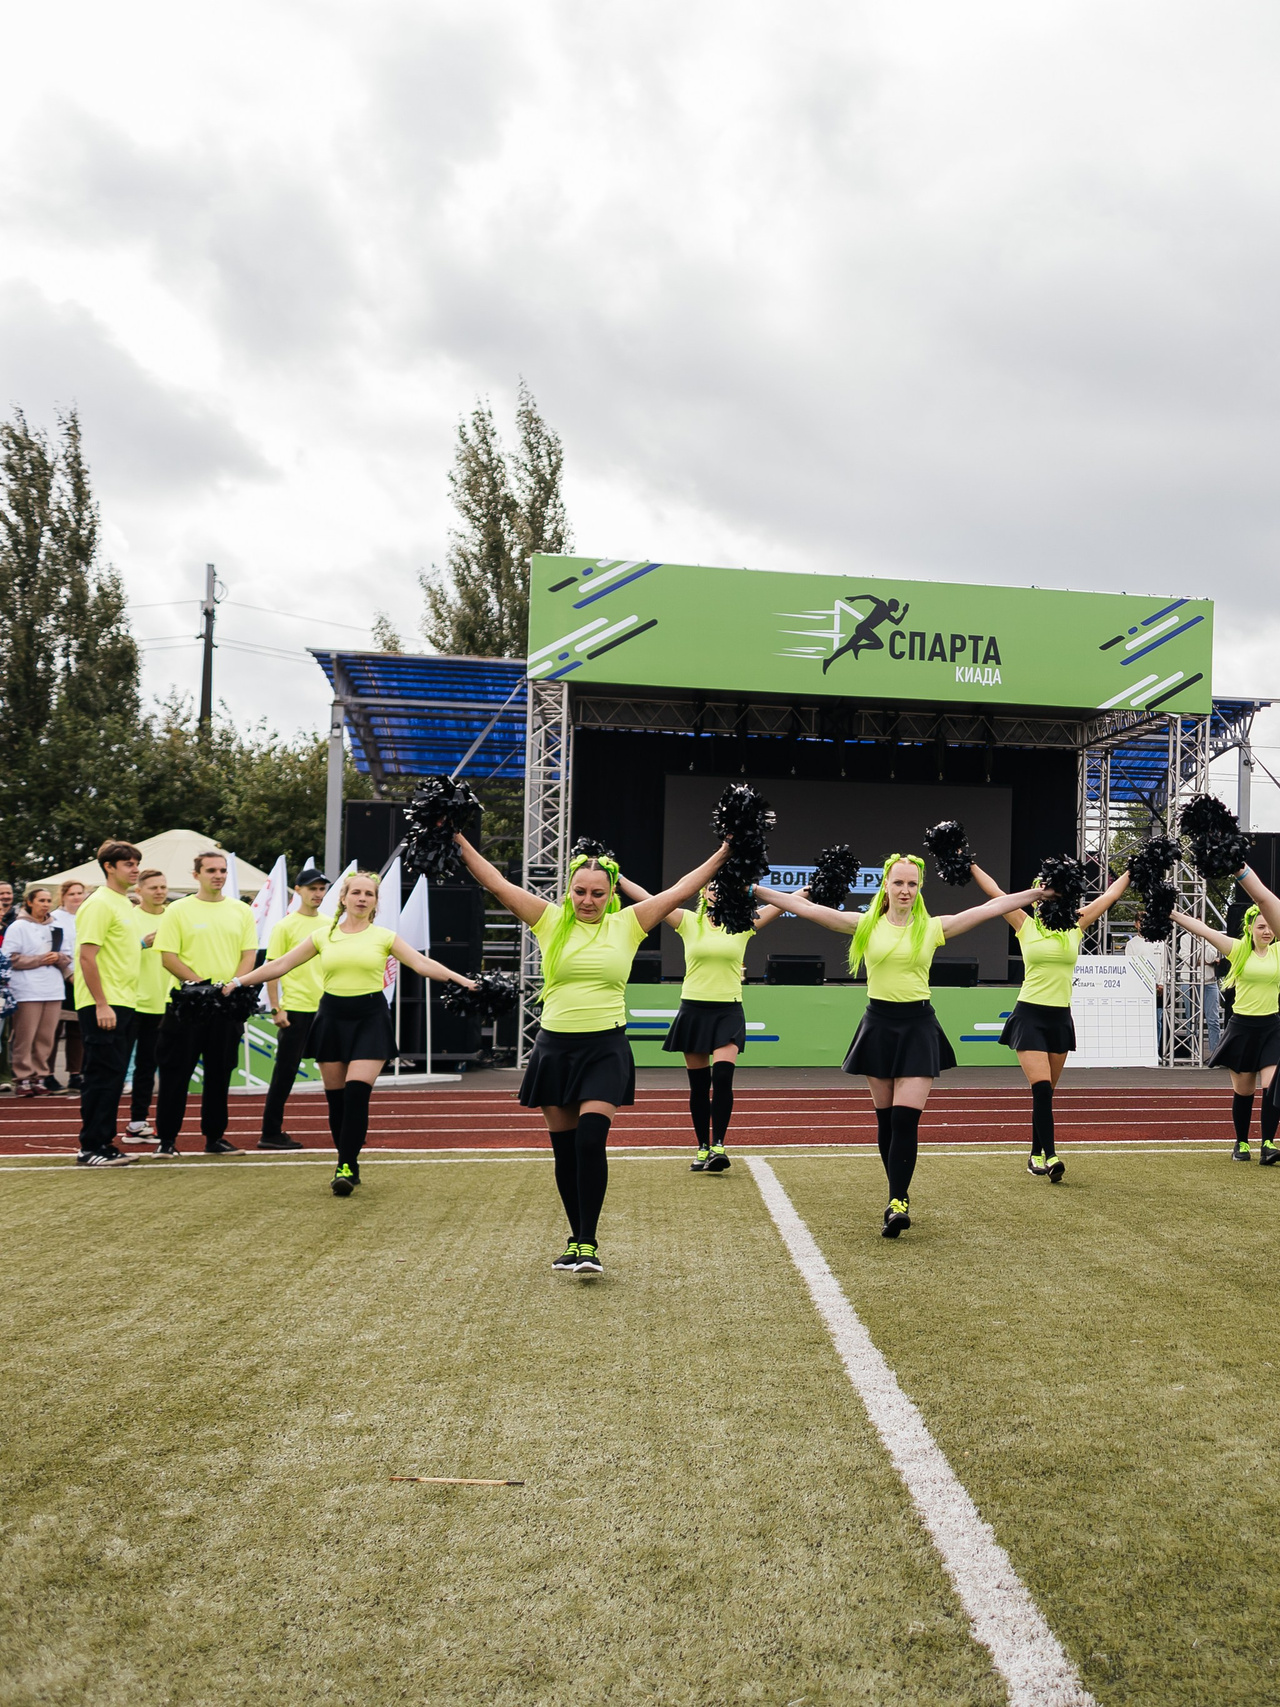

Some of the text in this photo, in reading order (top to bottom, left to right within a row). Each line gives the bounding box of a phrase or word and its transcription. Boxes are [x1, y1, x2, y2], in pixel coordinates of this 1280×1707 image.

[888, 629, 1002, 666] СПАРТА
[955, 666, 1002, 687] КИАДА
[770, 871, 812, 886] ВОЛ
[1095, 965, 1127, 975] ТАБЛИЦА
[1103, 979, 1121, 988] 2024
